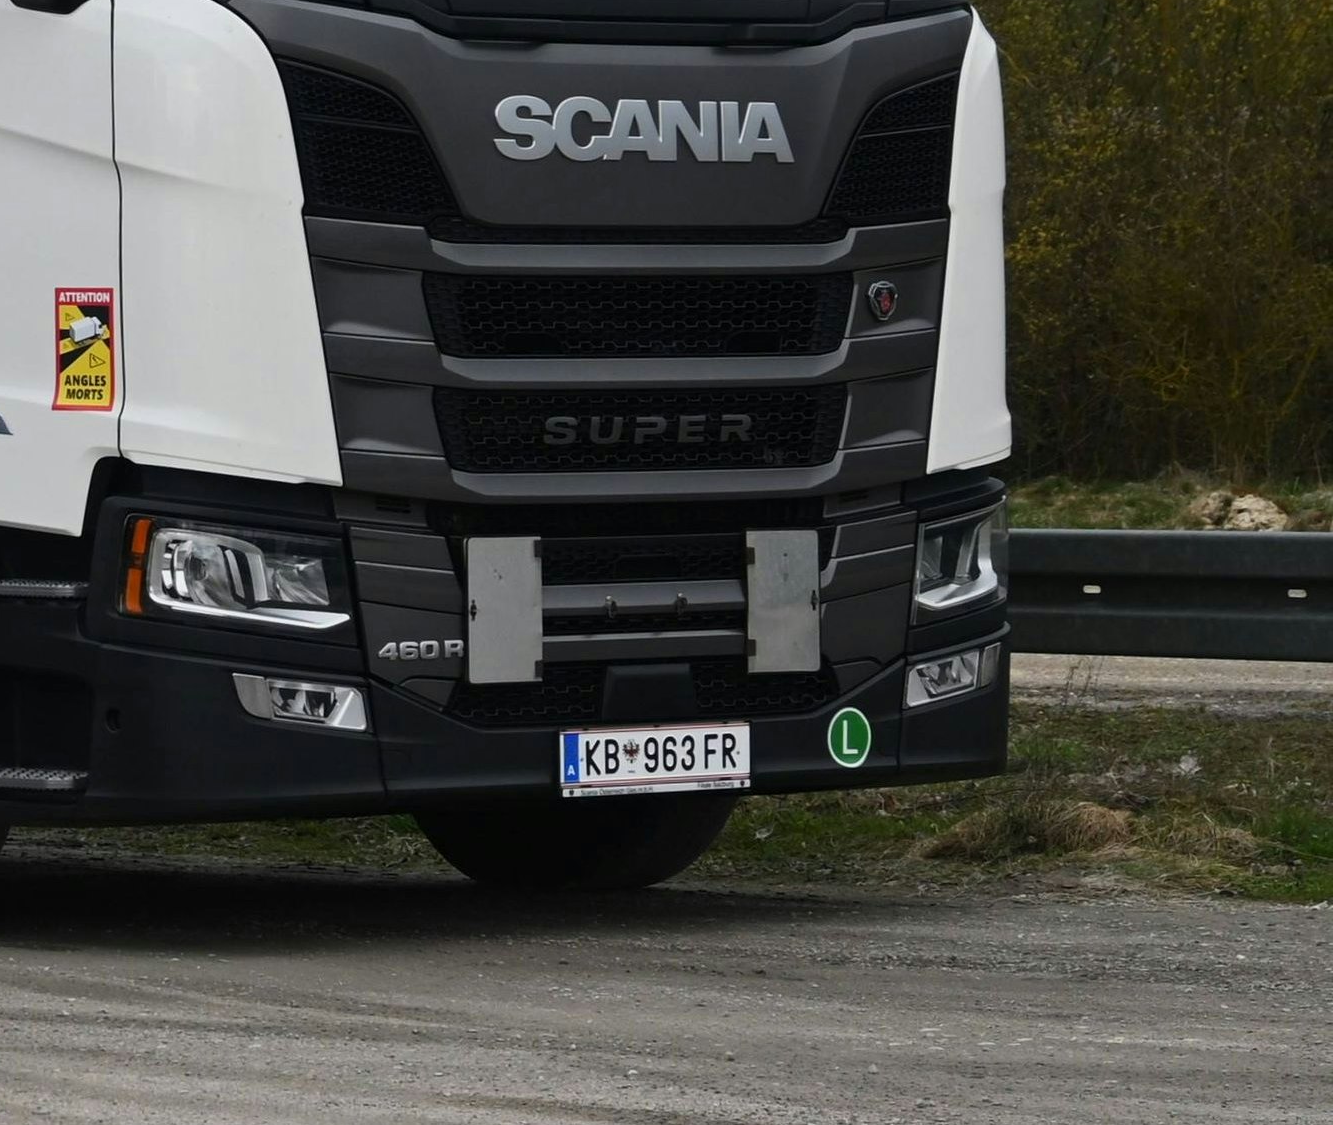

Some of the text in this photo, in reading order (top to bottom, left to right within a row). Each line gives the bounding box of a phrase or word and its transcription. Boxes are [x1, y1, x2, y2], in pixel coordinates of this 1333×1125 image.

[493, 94, 795, 163] SCANIA
[59, 291, 110, 303] ATTENTION
[64, 374, 107, 387] ANGLES
[65, 388, 104, 401] MORTS
[543, 414, 752, 446] SUPER
[378, 639, 464, 661] 460 R
[842, 719, 859, 755] L
[585, 733, 737, 777] KB 963 FR
[567, 764, 576, 777] A
